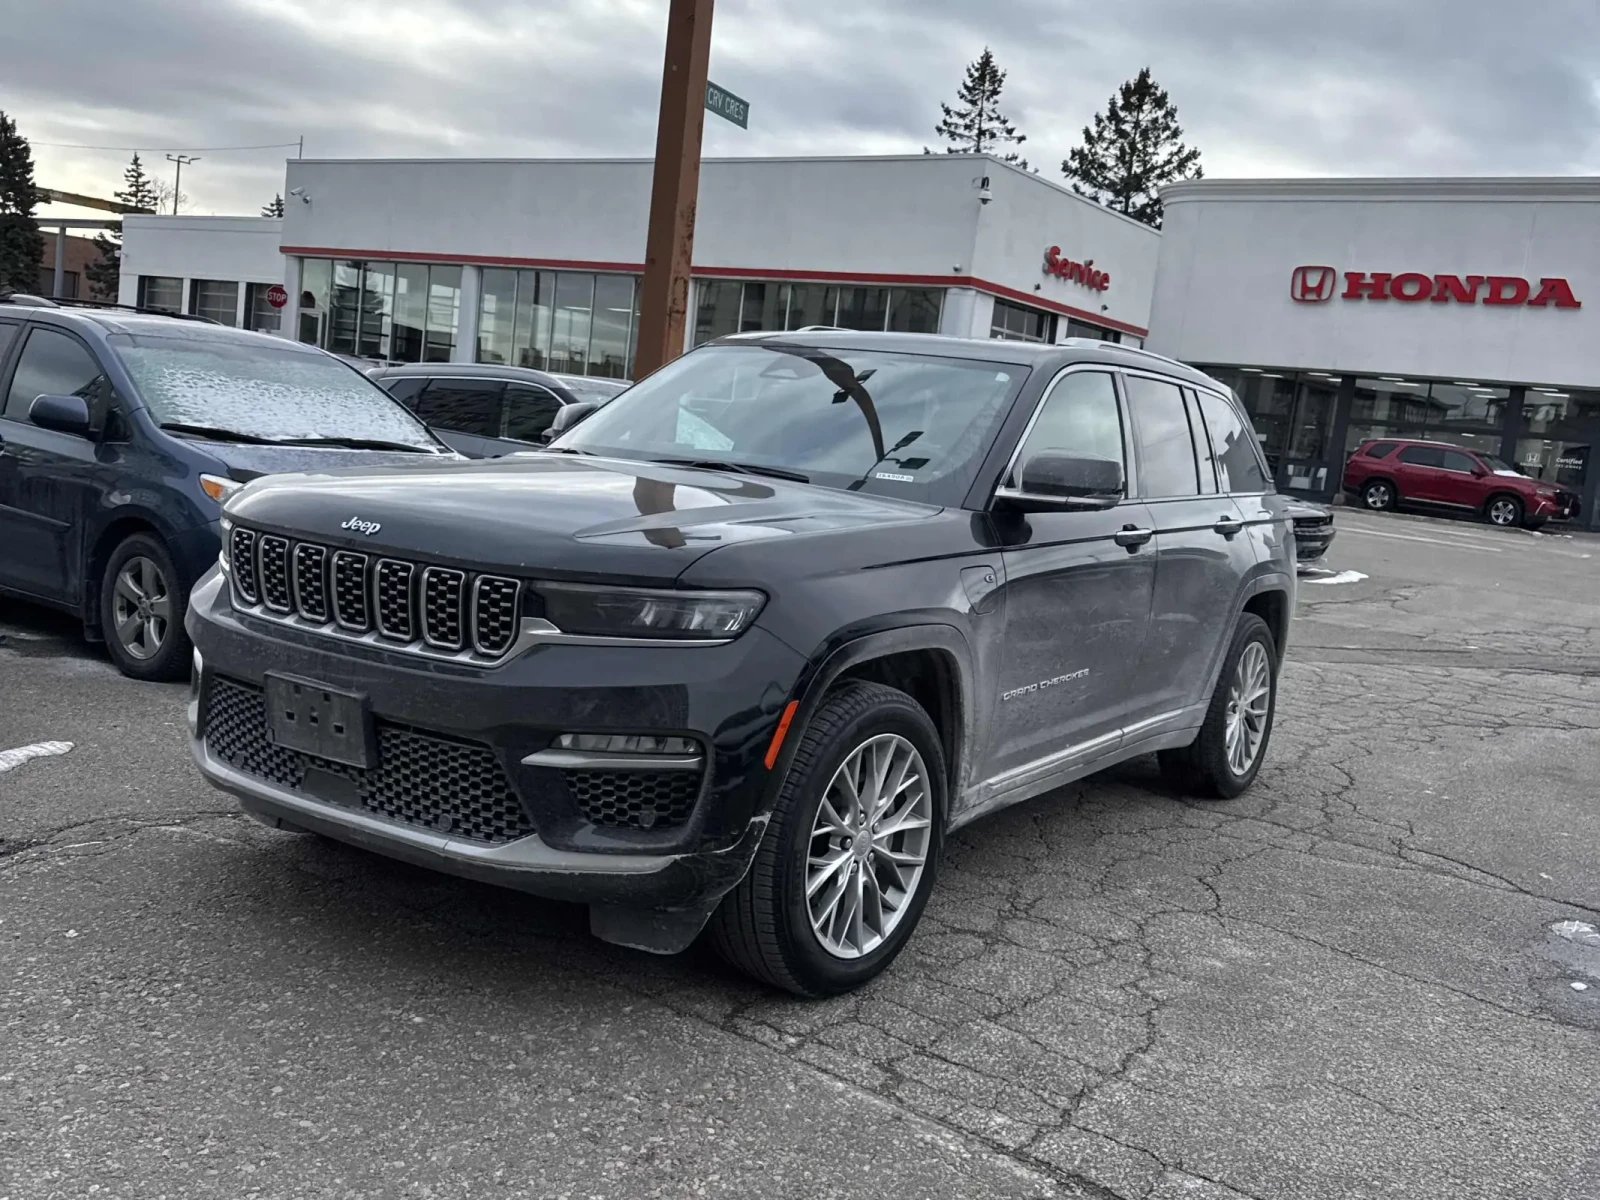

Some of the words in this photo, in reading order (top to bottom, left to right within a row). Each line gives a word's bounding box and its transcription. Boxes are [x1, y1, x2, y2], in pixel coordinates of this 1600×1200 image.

[707, 87, 723, 109] CRV
[724, 97, 744, 121] CRES
[1043, 246, 1110, 291] Service
[268, 292, 287, 302] STOP
[1341, 271, 1582, 309] HONDA
[1556, 457, 1583, 465] Certified
[341, 516, 381, 536] Jeep
[1003, 683, 1038, 701] GRAND
[1040, 668, 1090, 689] CHEROKEE
